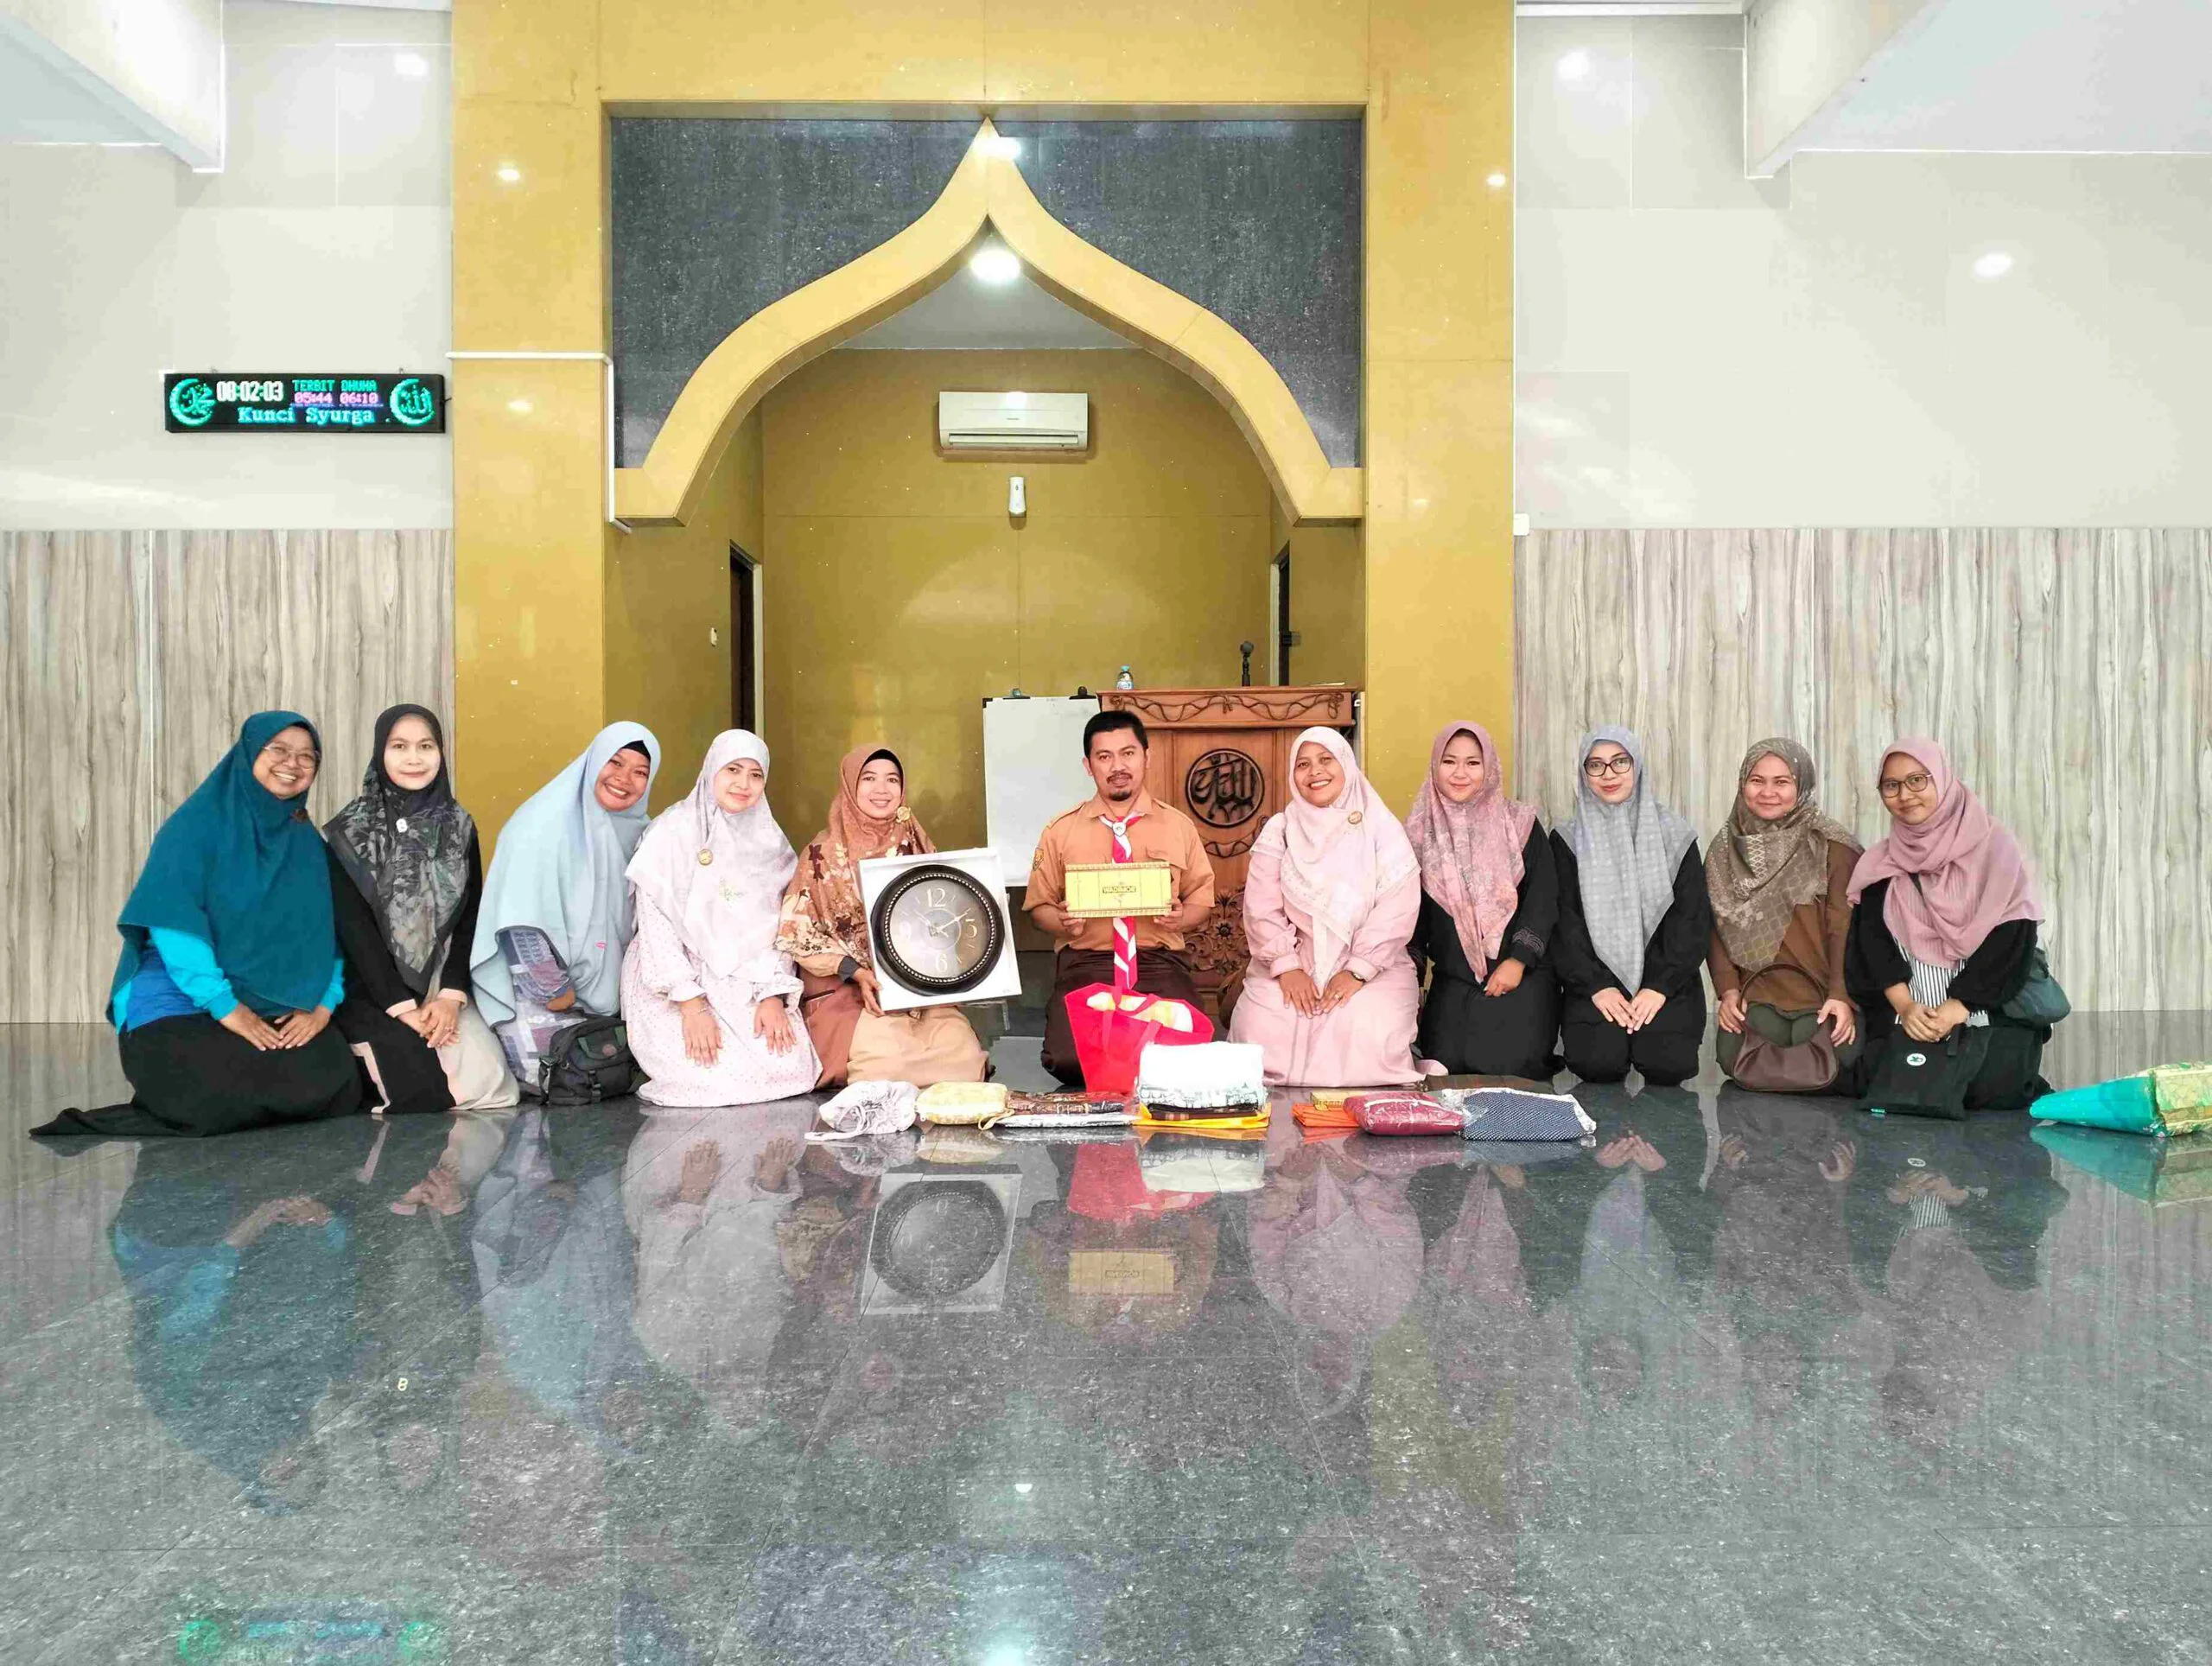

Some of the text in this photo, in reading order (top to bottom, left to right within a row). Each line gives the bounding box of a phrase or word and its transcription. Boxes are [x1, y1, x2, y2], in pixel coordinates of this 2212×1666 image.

[216, 380, 284, 403] 08:02:03
[291, 379, 336, 392] TERBIT
[294, 391, 378, 404] 05:44 06:10
[238, 406, 376, 426] Kunci Syurga
[926, 887, 946, 908] 12
[964, 918, 978, 938] 3
[935, 952, 948, 973] 6
